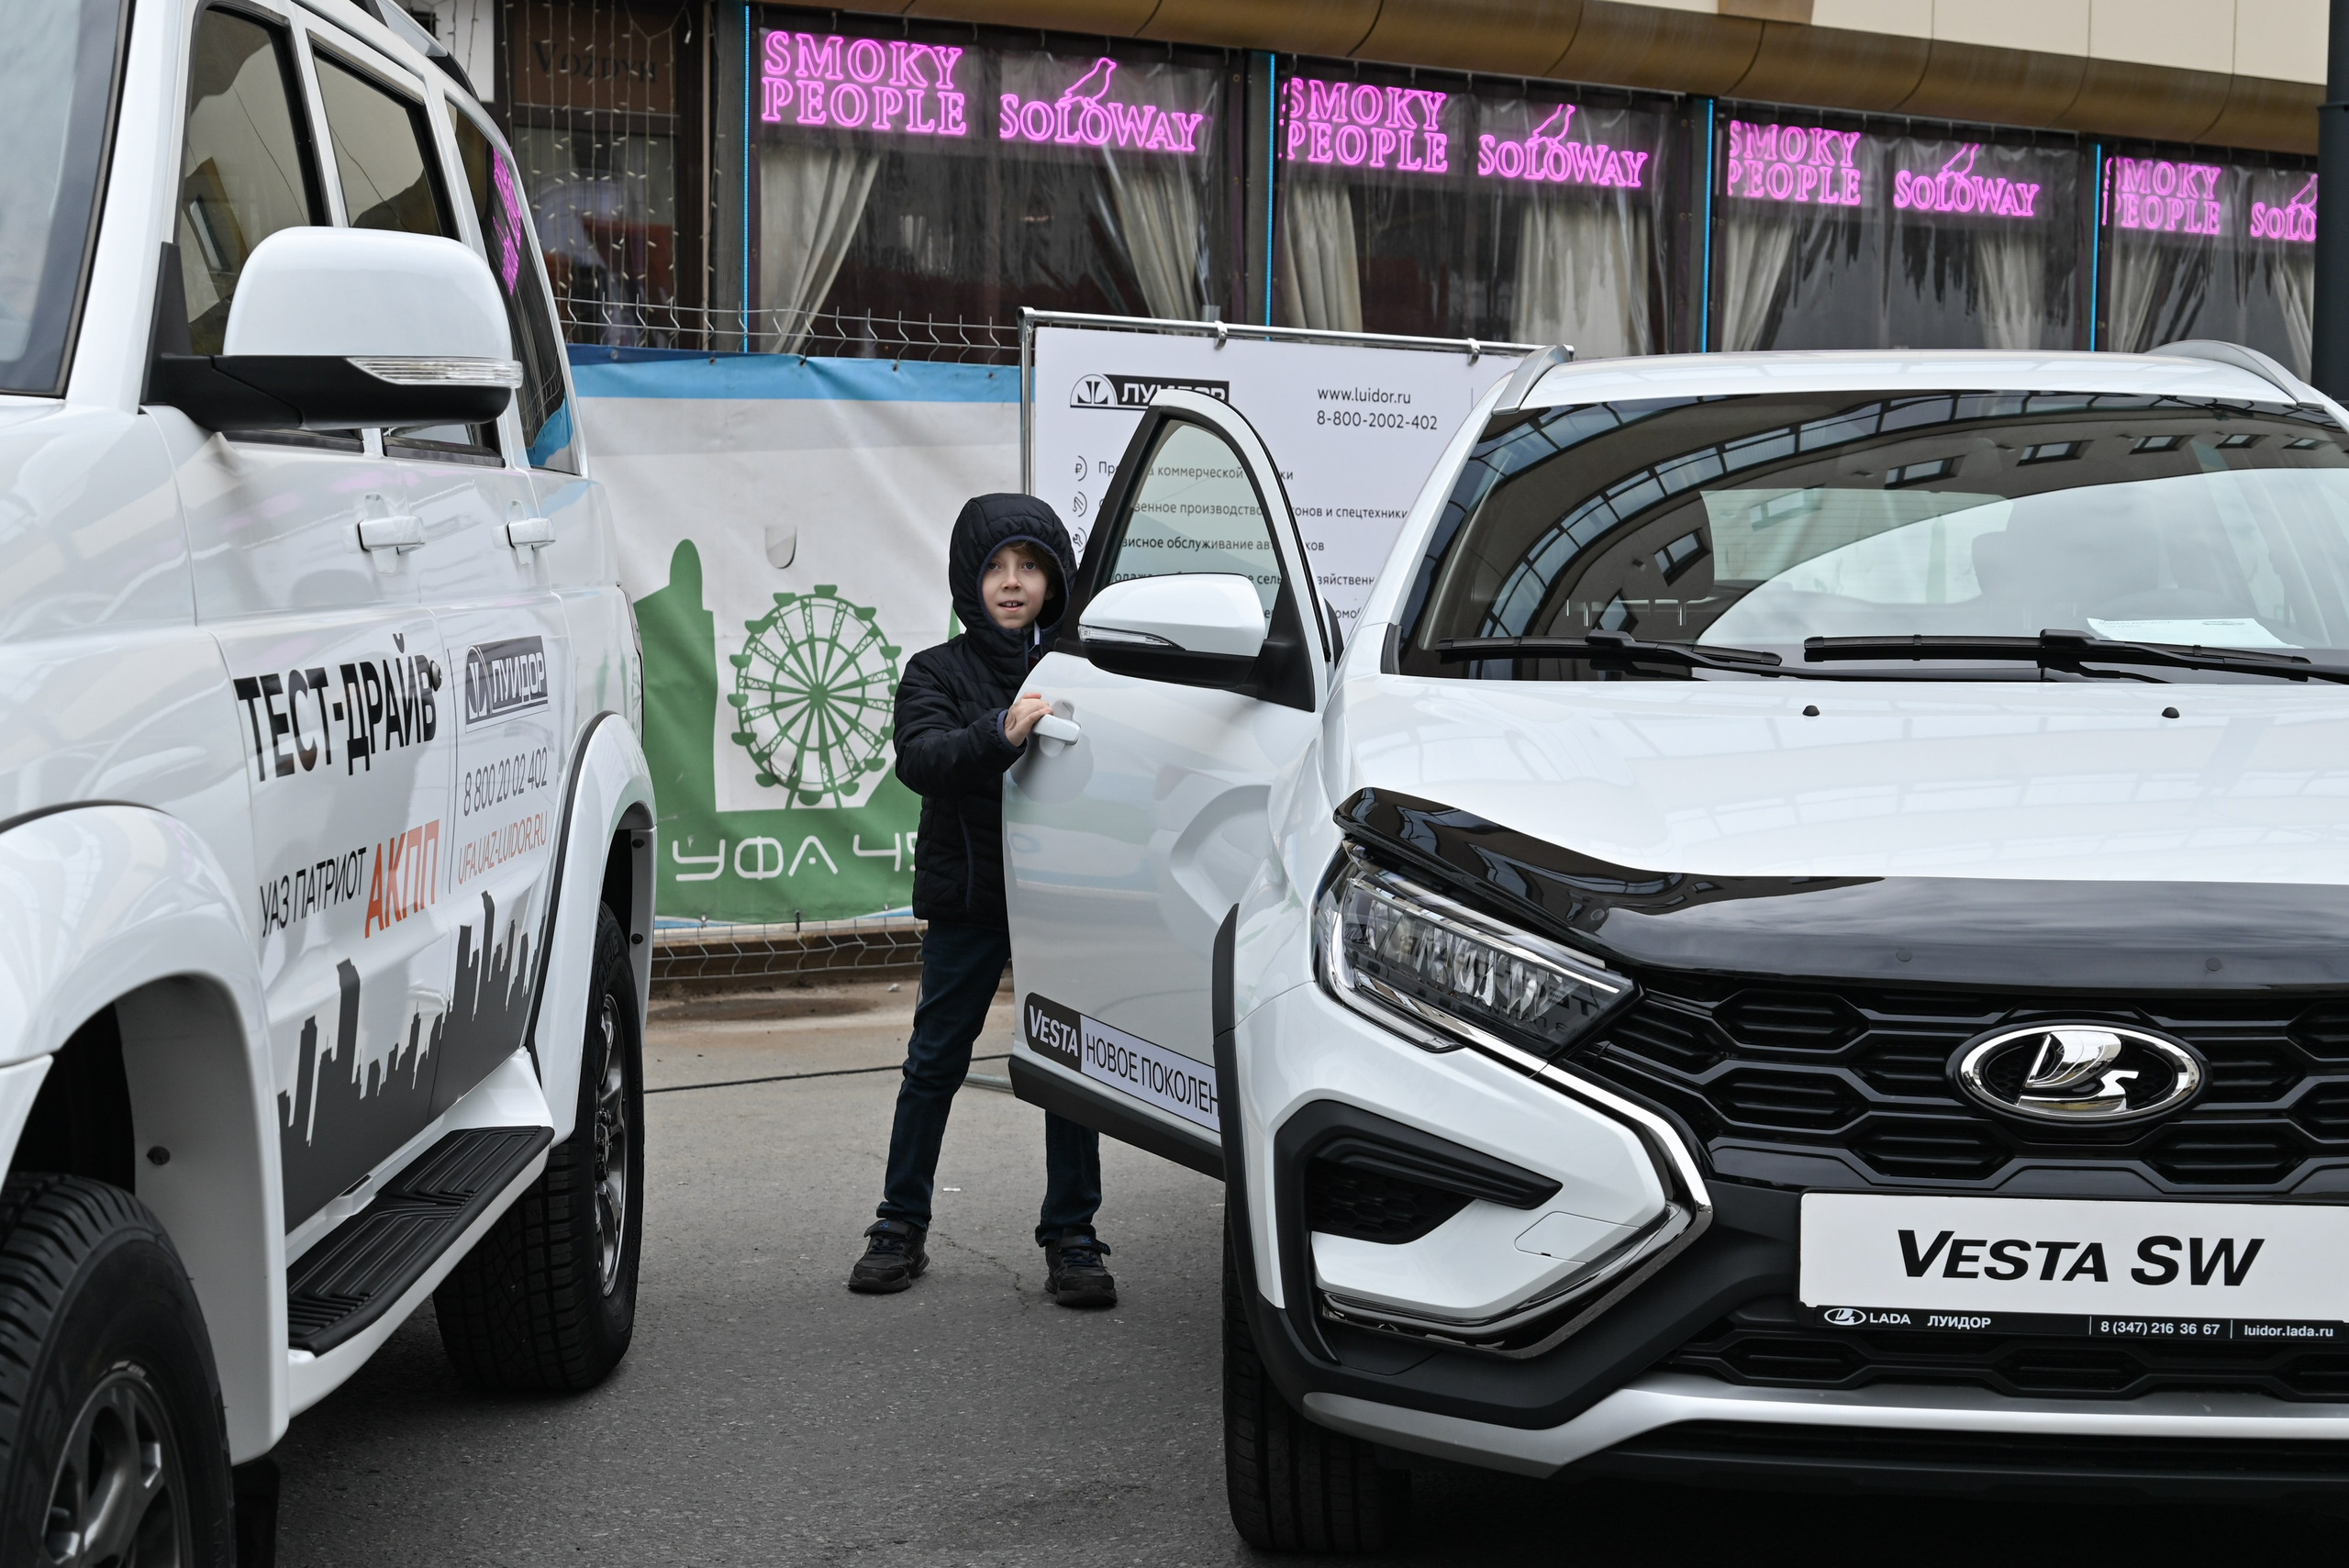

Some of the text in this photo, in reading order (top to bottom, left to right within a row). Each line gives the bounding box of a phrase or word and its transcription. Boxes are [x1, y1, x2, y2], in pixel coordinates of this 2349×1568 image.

[762, 30, 963, 90] SMOKY
[761, 75, 966, 135] PEOPLE
[999, 93, 1203, 151] SOLOWAY
[1280, 77, 1447, 130] SMOKY
[1277, 120, 1447, 172] PEOPLE
[1477, 134, 1648, 187] SOLOWAY
[1729, 119, 1861, 167] SMOKY
[1727, 158, 1861, 206] PEOPLE
[1893, 170, 2040, 217] SOLOWAY
[2250, 201, 2317, 242] SOLO
[1316, 409, 1438, 430] 8-800-2002-402
[1318, 387, 1411, 404] www.luidor.ru
[1158, 465, 1243, 479] коммерческой
[1326, 507, 1333, 517] и
[1166, 536, 1253, 552] обслуживание
[491, 651, 545, 703] ЛУИДОР
[233, 633, 438, 782] ТЕСТ-ДРАЙВ
[463, 746, 548, 817] 8 800 20 02 402
[260, 819, 440, 939] УАЗ ПАТРИОТ АКПП
[672, 835, 839, 883] УФА
[1029, 1005, 1079, 1057] VESTA
[1085, 1032, 1219, 1115] НОВОЕ ПОКОЛЕН
[1898, 1229, 2266, 1287] VESTA SW
[1869, 1312, 1912, 1325] LADA
[1927, 1315, 1992, 1330] ЛУИДОР
[2100, 1321, 2221, 1336] 8 (347) 216 36 67
[2243, 1325, 2334, 1338] luidor.lada.ru
